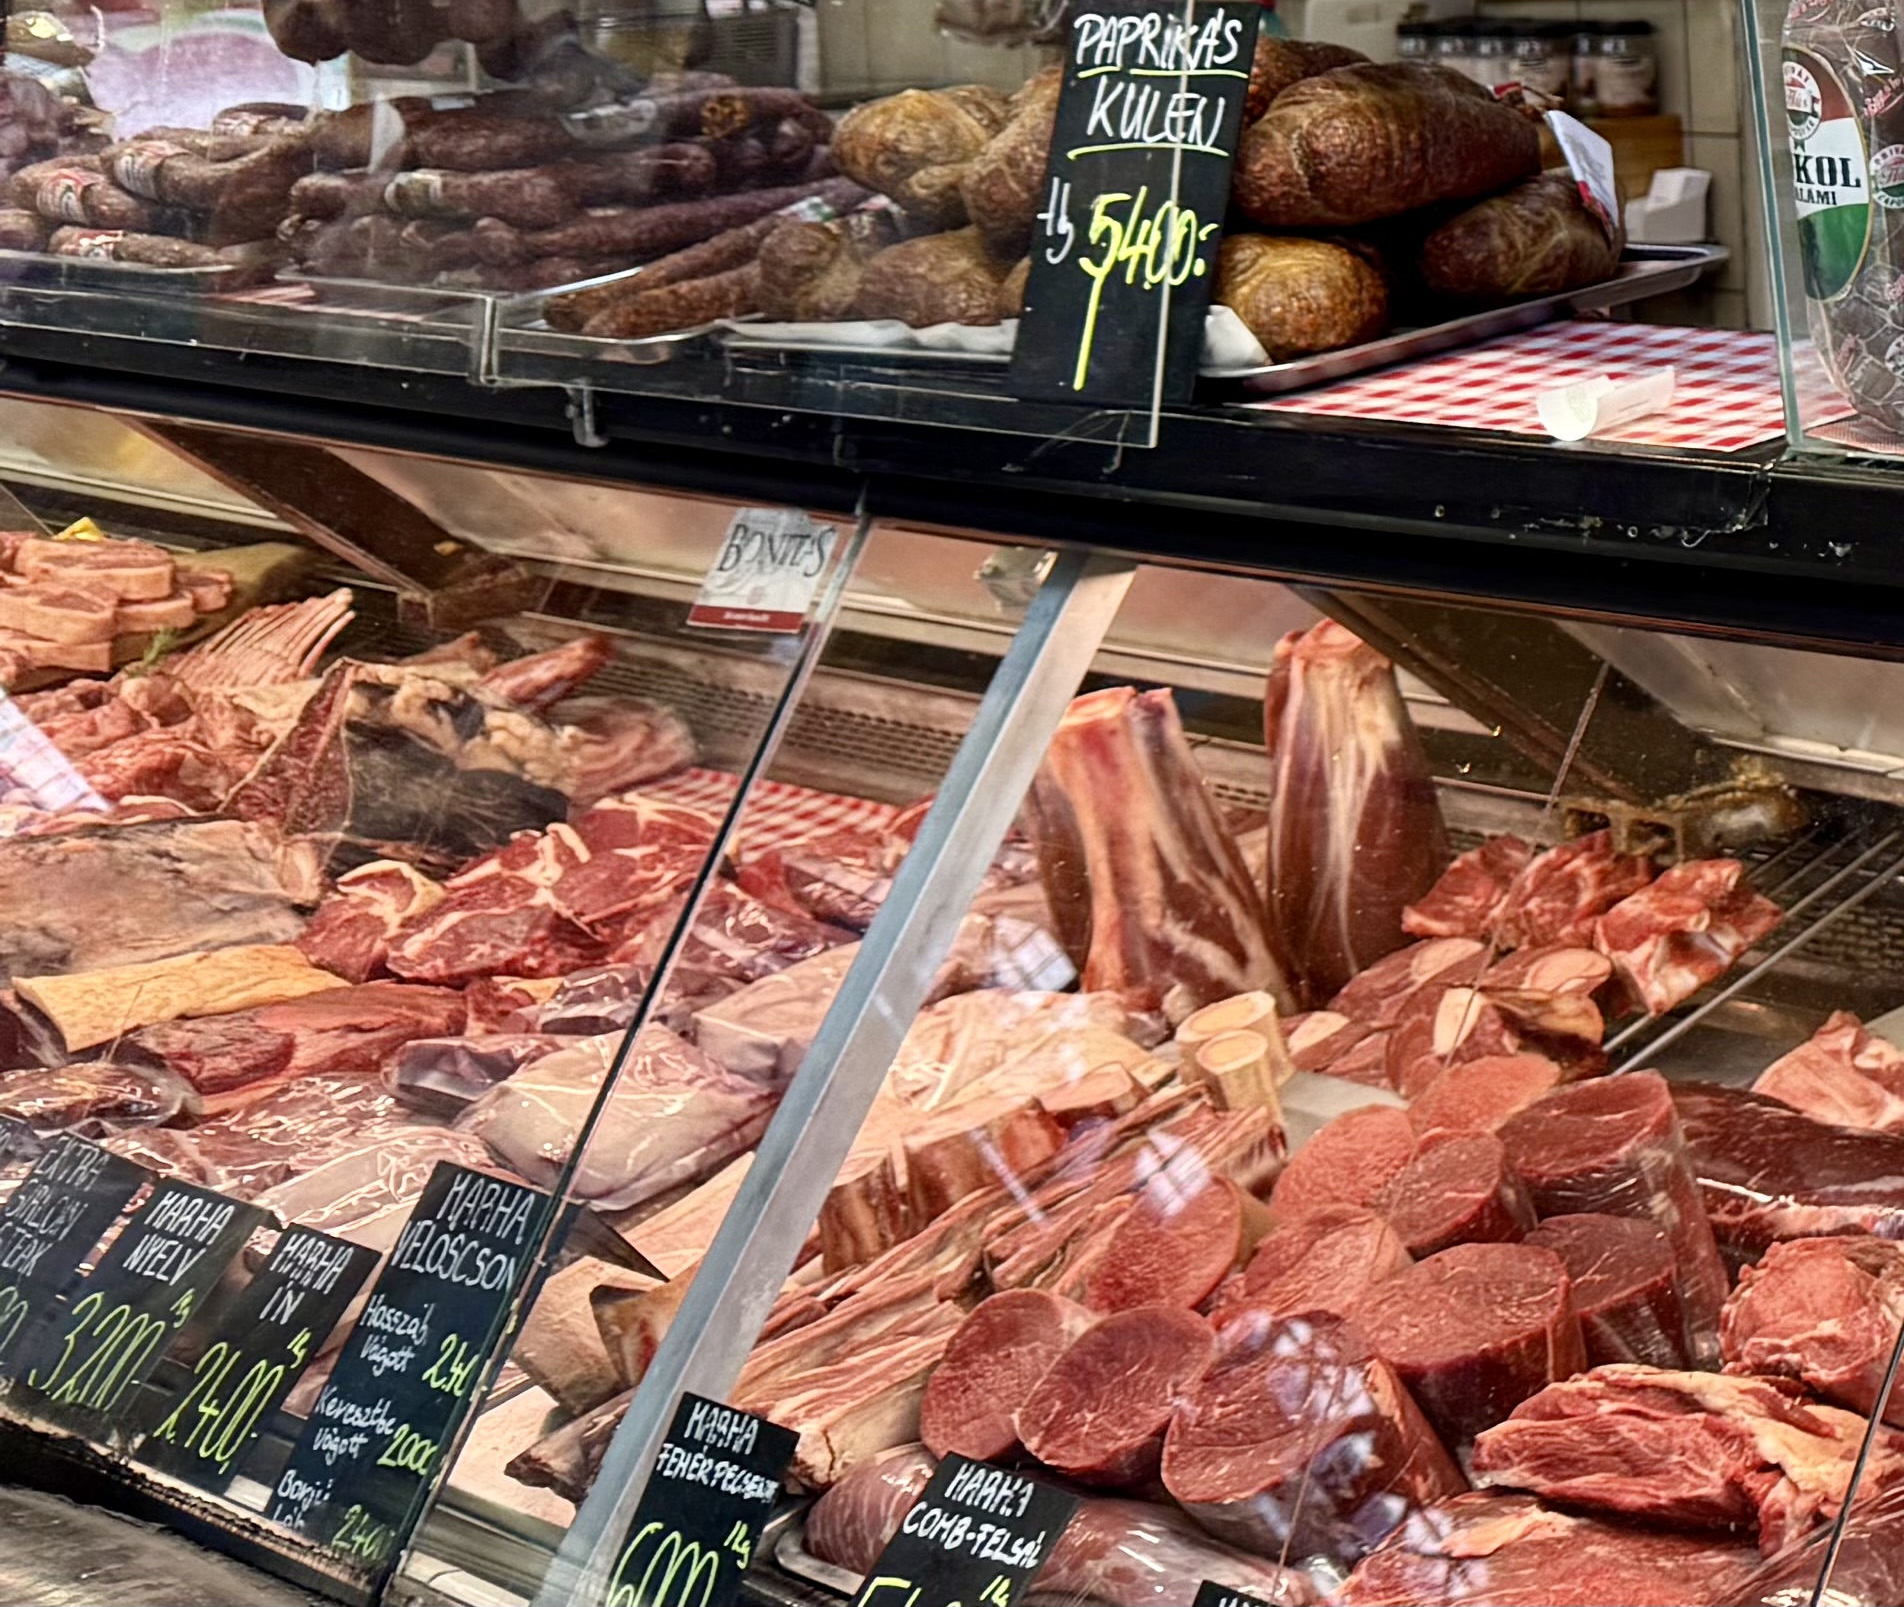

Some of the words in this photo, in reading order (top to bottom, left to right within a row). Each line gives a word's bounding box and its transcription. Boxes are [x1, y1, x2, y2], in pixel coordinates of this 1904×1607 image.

[143, 1190, 236, 1246] MARHA
[437, 1172, 535, 1245] MARHA
[122, 1233, 207, 1286] NYELV
[269, 1231, 354, 1295] MARHA
[683, 1400, 760, 1456] MARHA
[944, 1462, 1036, 1518] MARHA
